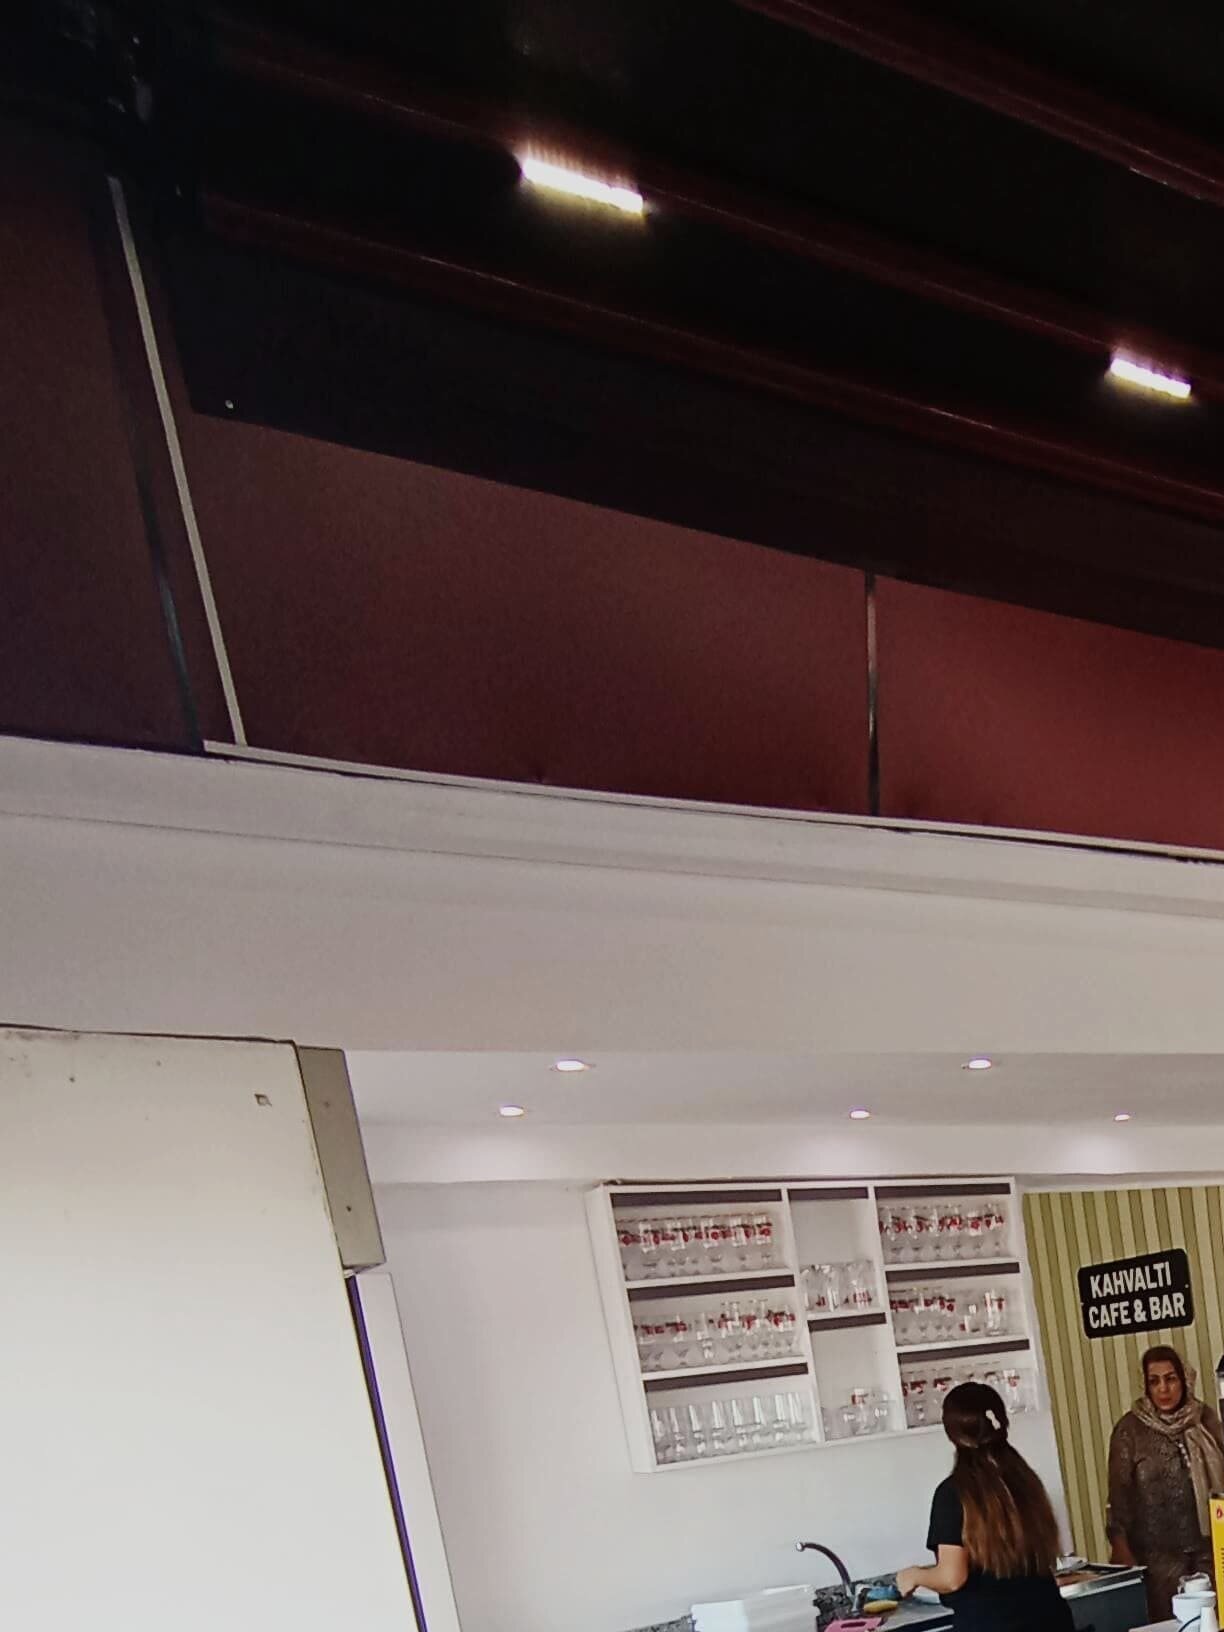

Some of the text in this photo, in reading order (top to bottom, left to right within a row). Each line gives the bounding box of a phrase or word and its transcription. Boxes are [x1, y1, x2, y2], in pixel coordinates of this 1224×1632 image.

[1090, 1261, 1172, 1299] KAHVALTI
[1088, 1292, 1187, 1329] CAFE & BAR
